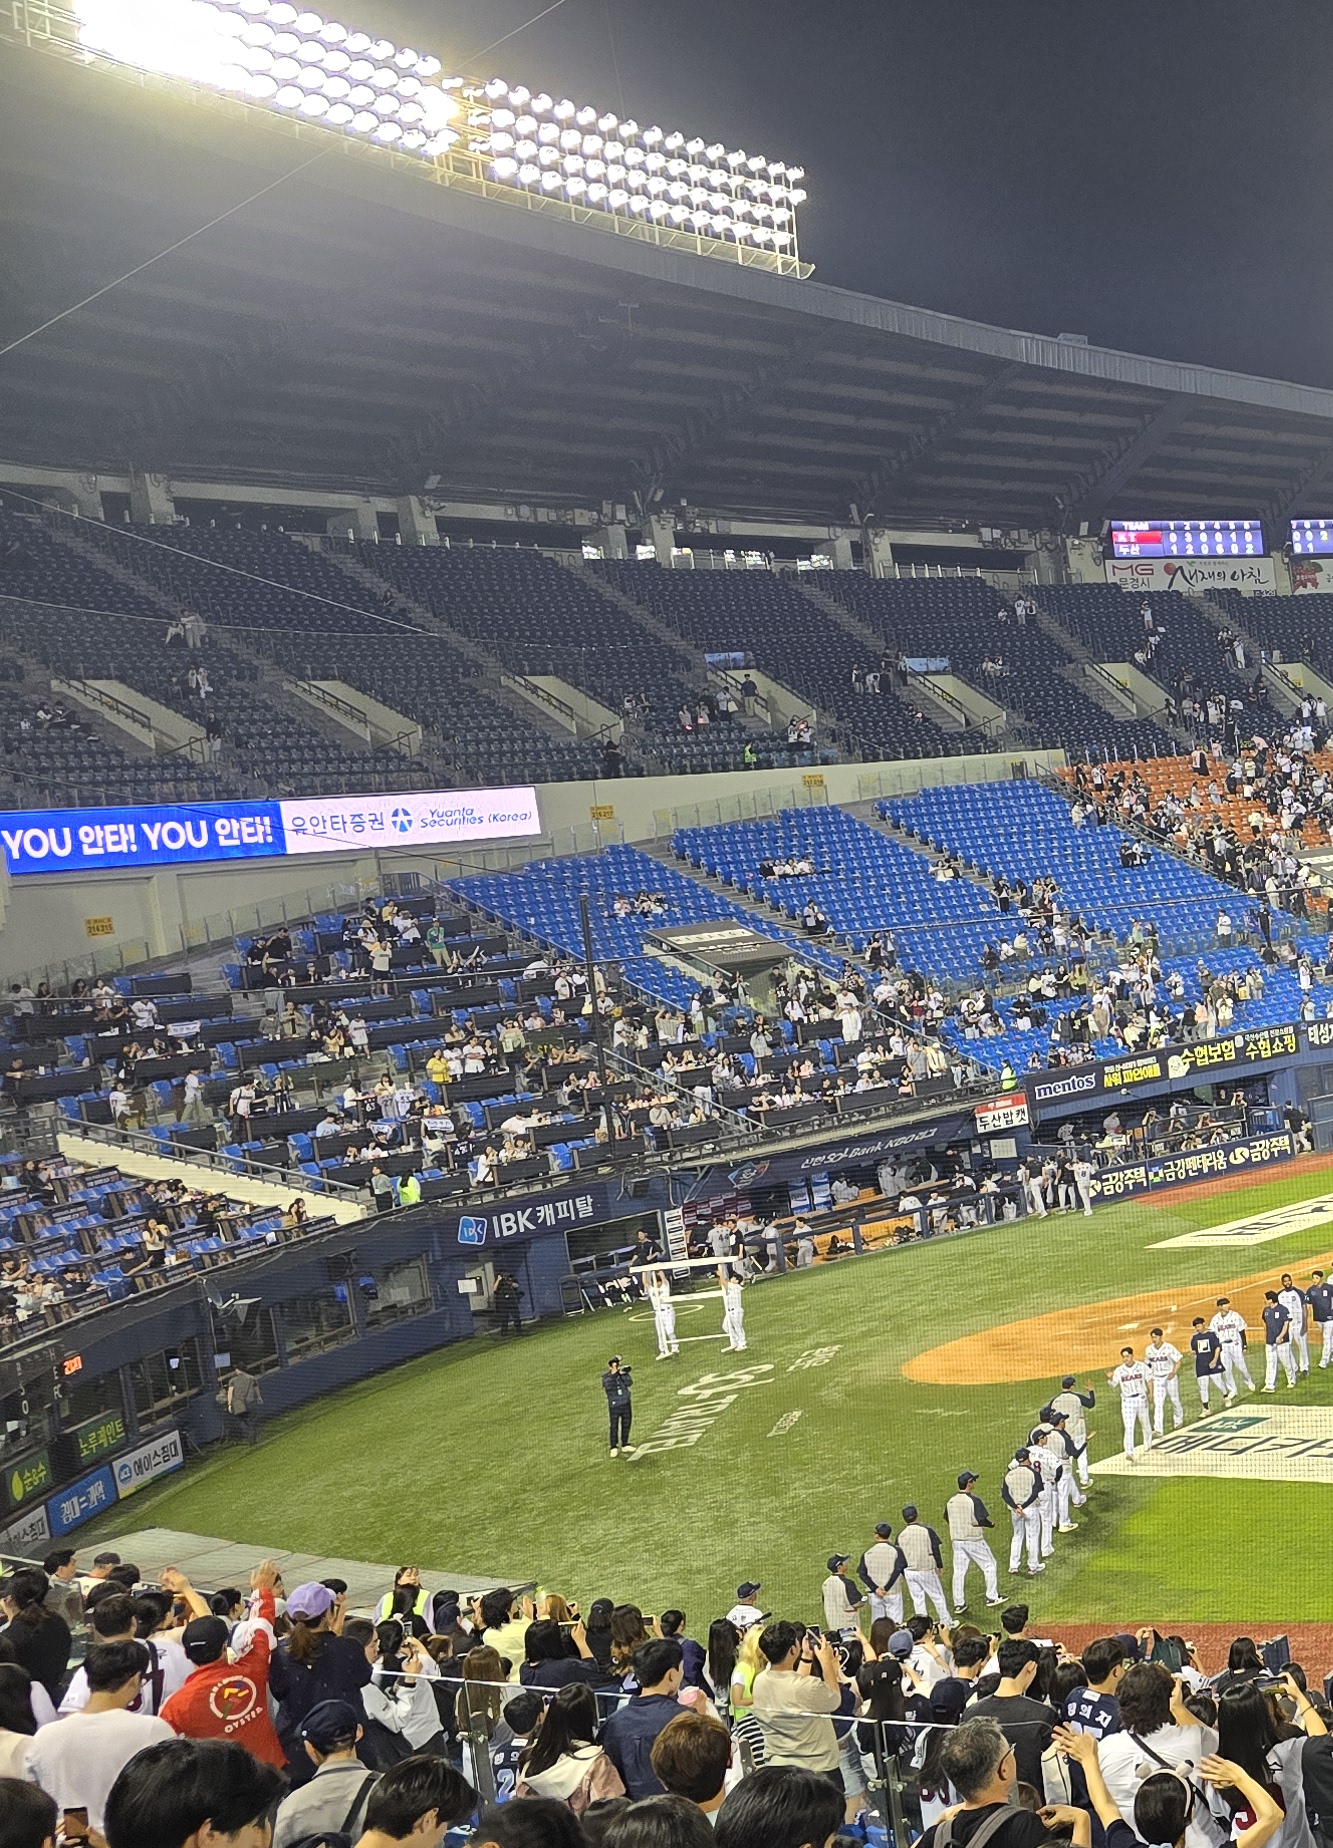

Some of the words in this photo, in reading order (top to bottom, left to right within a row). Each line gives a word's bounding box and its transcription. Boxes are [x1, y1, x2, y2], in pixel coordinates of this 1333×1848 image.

[1112, 564, 1154, 576] MG
[1119, 577, 1150, 589] 문경시
[1231, 567, 1270, 585] 아침
[290, 811, 386, 836] 유안타증권
[420, 815, 484, 829] Securities
[487, 809, 533, 826] (Korea)
[428, 806, 475, 820] Yuanta
[2, 827, 72, 860] YOU
[78, 822, 138, 855] 안타!
[141, 820, 209, 850] YOU
[214, 815, 274, 846] 안타!
[1181, 1040, 1236, 1067] 수협보험
[1035, 1073, 1095, 1100] mentos
[979, 1107, 1027, 1130] 두산밥캣
[851, 1140, 885, 1157] Bank
[1250, 1136, 1291, 1163] 금강주택
[1164, 1150, 1227, 1182] 금강펜테리움
[1102, 1166, 1147, 1194] 금강주택
[493, 1209, 533, 1239] IBK
[535, 1195, 594, 1228] 캐피탈
[133, 1439, 179, 1477] 에이스침대
[224, 1706, 264, 1734] OYSTER
